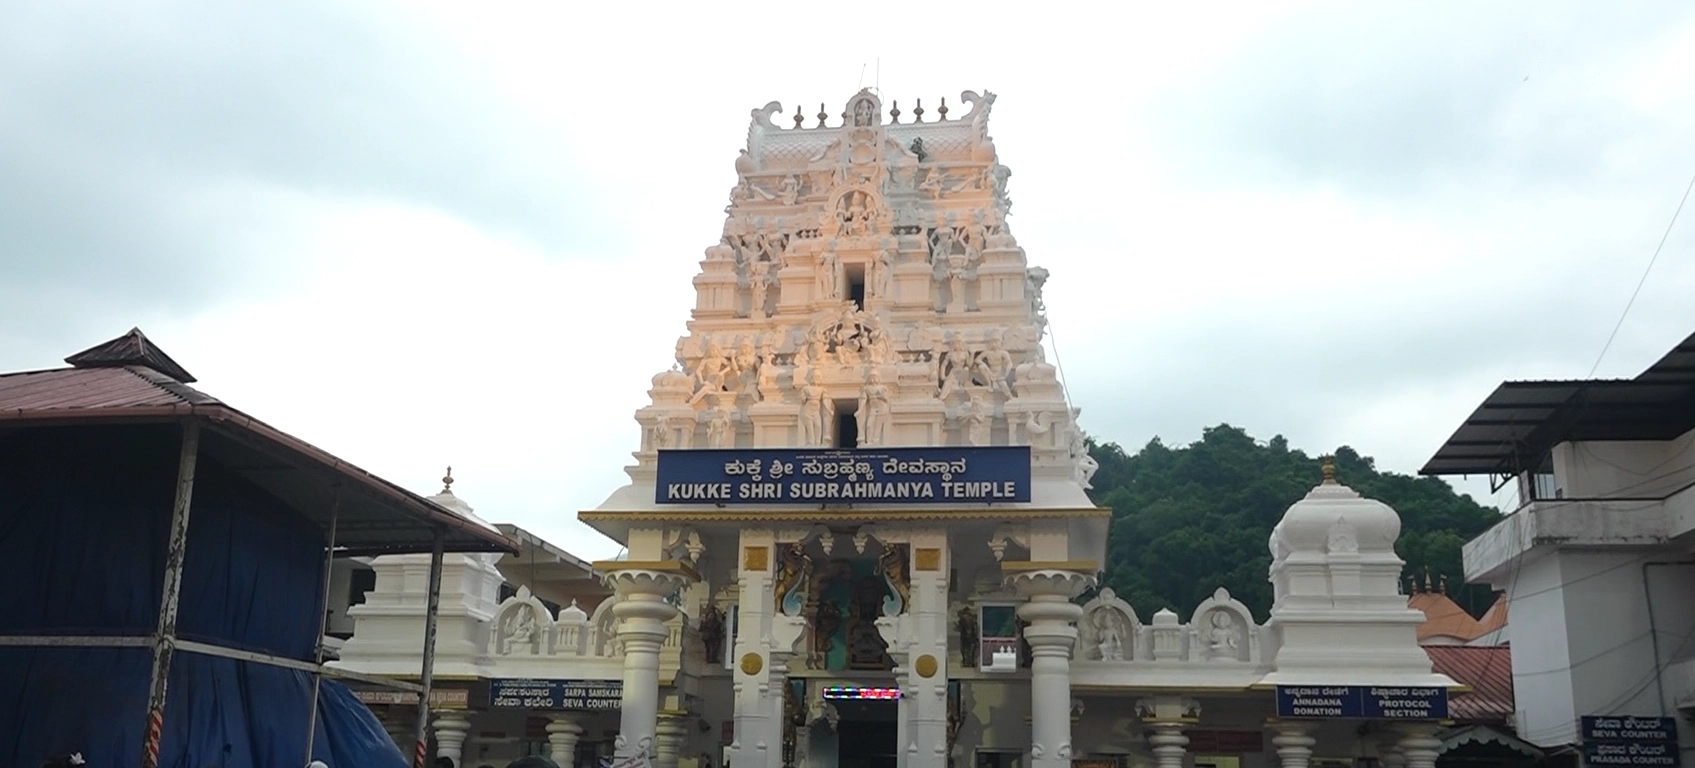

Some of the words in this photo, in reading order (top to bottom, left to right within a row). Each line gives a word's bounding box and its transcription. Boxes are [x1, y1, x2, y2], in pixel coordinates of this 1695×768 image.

[724, 458, 762, 482] ಕುಕ್ಕೆ
[769, 459, 793, 479] ಶ್ರೀ
[802, 458, 874, 482] ಸುಬ್ರಹ್ಮಣ್ಯ
[882, 457, 966, 482] ದೇವಸ್ಥಾನ
[668, 483, 731, 499] KUKKE
[739, 482, 782, 498] SHRI
[789, 482, 934, 498] SUBRAHMANYA
[941, 481, 1015, 498] TEMPLE
[564, 688, 586, 697] SARPA
[494, 696, 522, 707] ಸೇವಾ
[562, 698, 583, 708] SEVA
[586, 698, 623, 708] COUNTER
[1292, 698, 1342, 706] ANNADANA
[1379, 700, 1432, 708] PROTOCOL
[1293, 707, 1342, 715] DONATION
[1383, 709, 1428, 717] SECTION
[1592, 729, 1618, 738] SEVA
[1621, 730, 1667, 739] COUNTER
[1590, 755, 1631, 764] PRASADA
[1632, 756, 1674, 765] COUNTER
